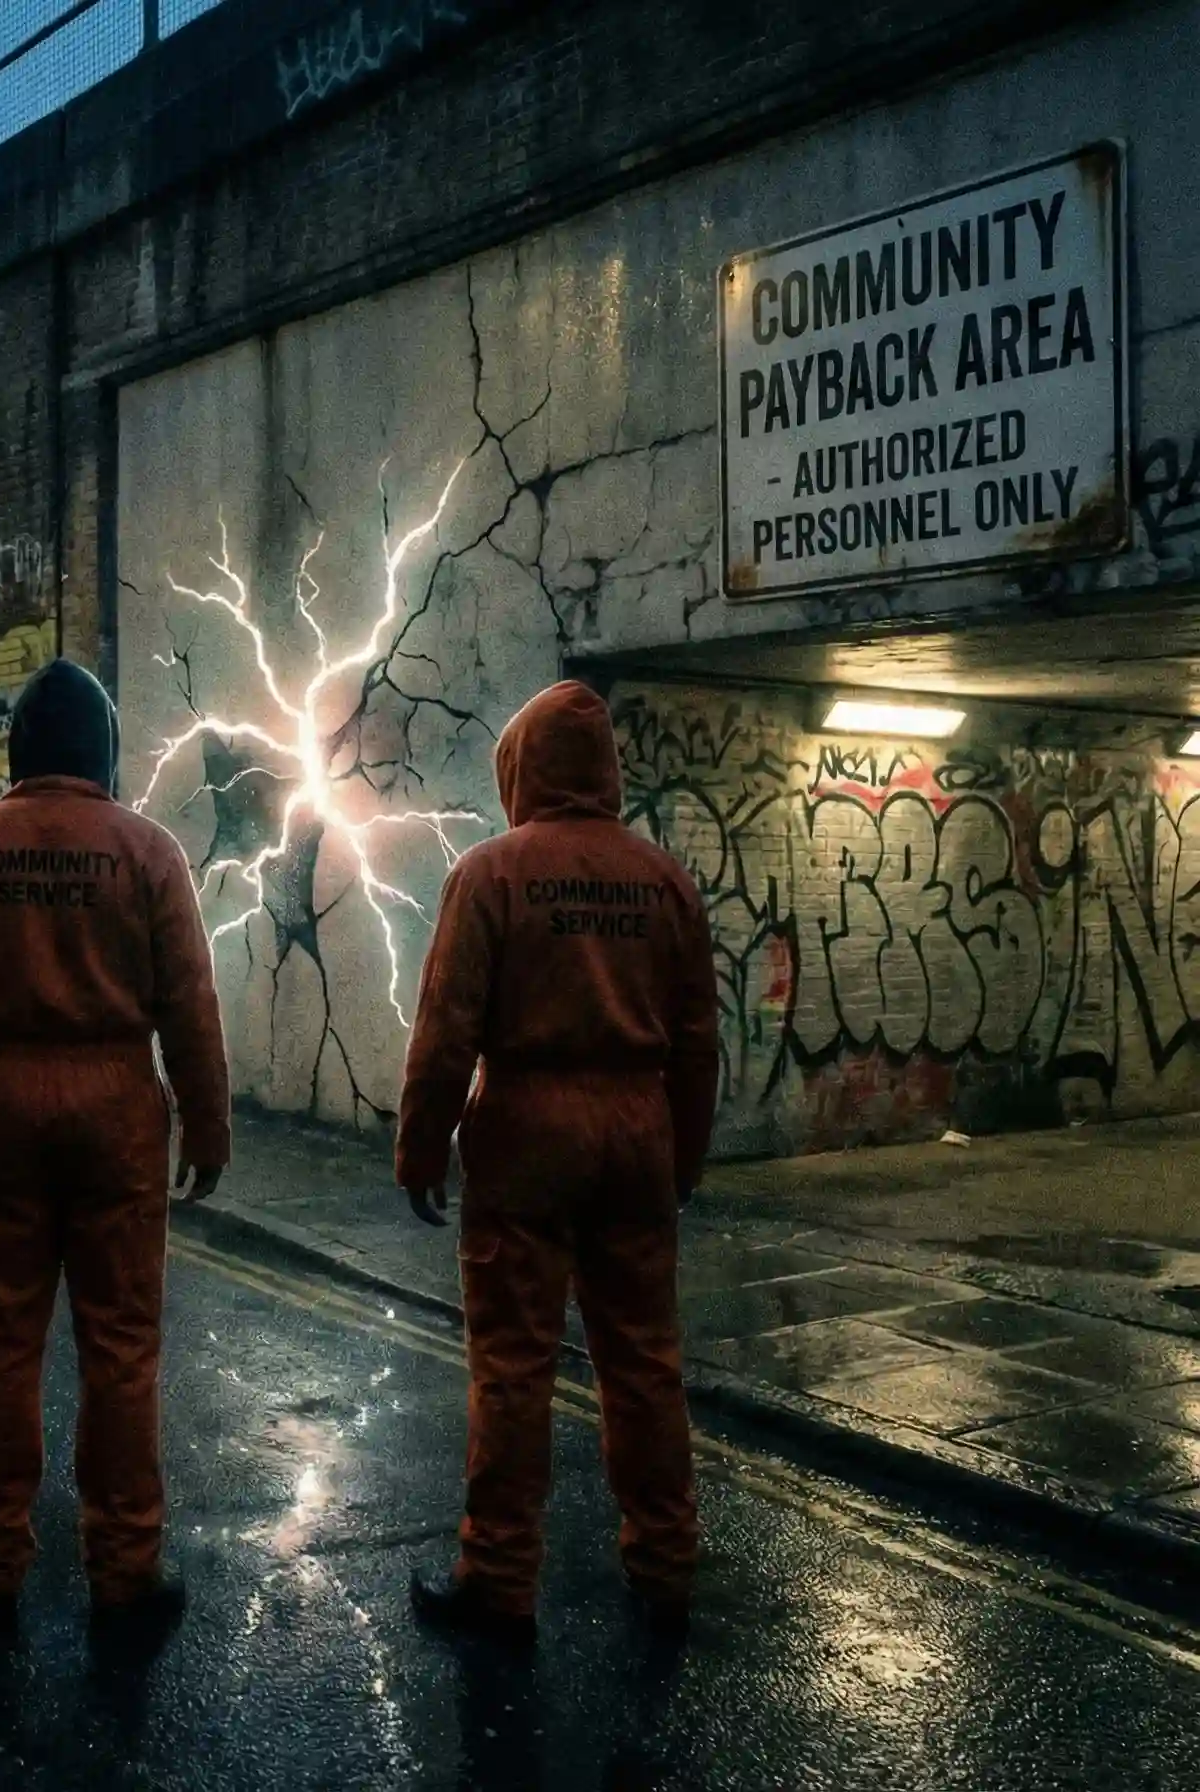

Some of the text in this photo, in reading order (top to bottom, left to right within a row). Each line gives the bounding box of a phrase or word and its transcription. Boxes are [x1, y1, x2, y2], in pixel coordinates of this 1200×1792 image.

[752, 190, 1066, 345] COMMUNITY
[740, 286, 1095, 438] PAYBACK AREA
[792, 409, 1026, 498] AUTHORIZED
[753, 488, 961, 563] PERSONNEL
[974, 466, 1079, 532] ONLY
[524, 877, 665, 907] COMMUNITY
[551, 910, 648, 938] SERVICE
